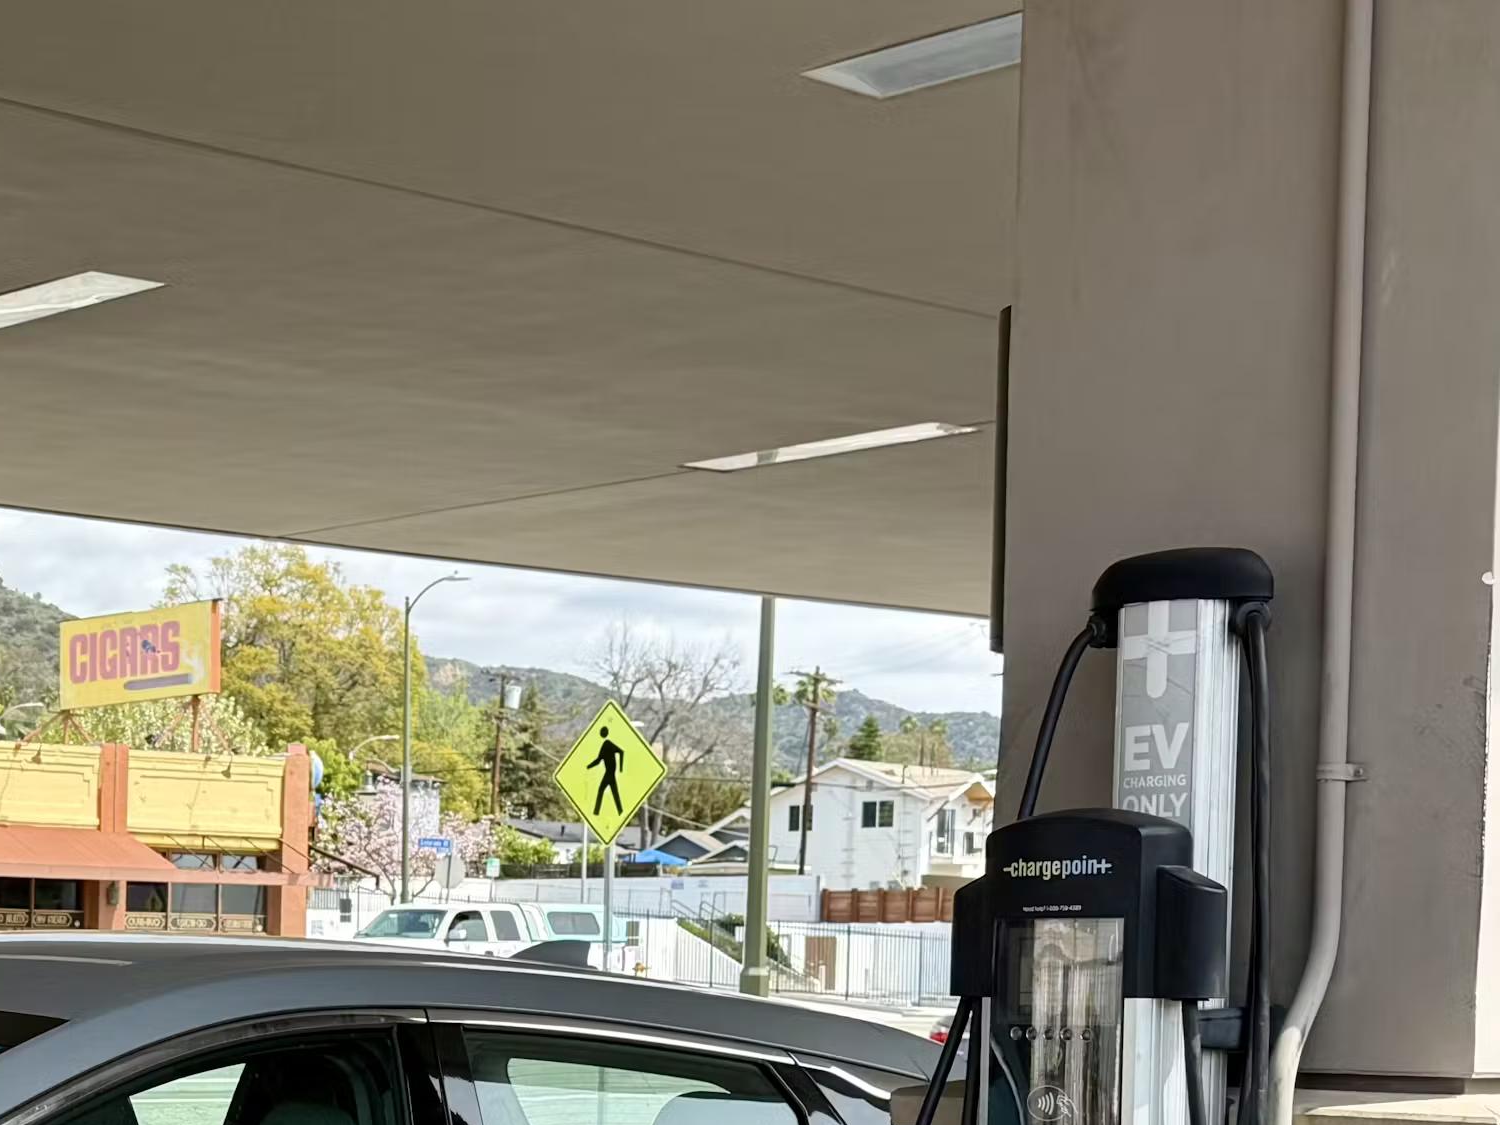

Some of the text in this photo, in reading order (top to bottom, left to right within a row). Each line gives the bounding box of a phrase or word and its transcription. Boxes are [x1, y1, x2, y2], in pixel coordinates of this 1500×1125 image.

[69, 620, 180, 684] CIGARS
[1124, 722, 1190, 771] EV
[1123, 774, 1187, 789] CHARGING
[1122, 792, 1188, 818] ONLY
